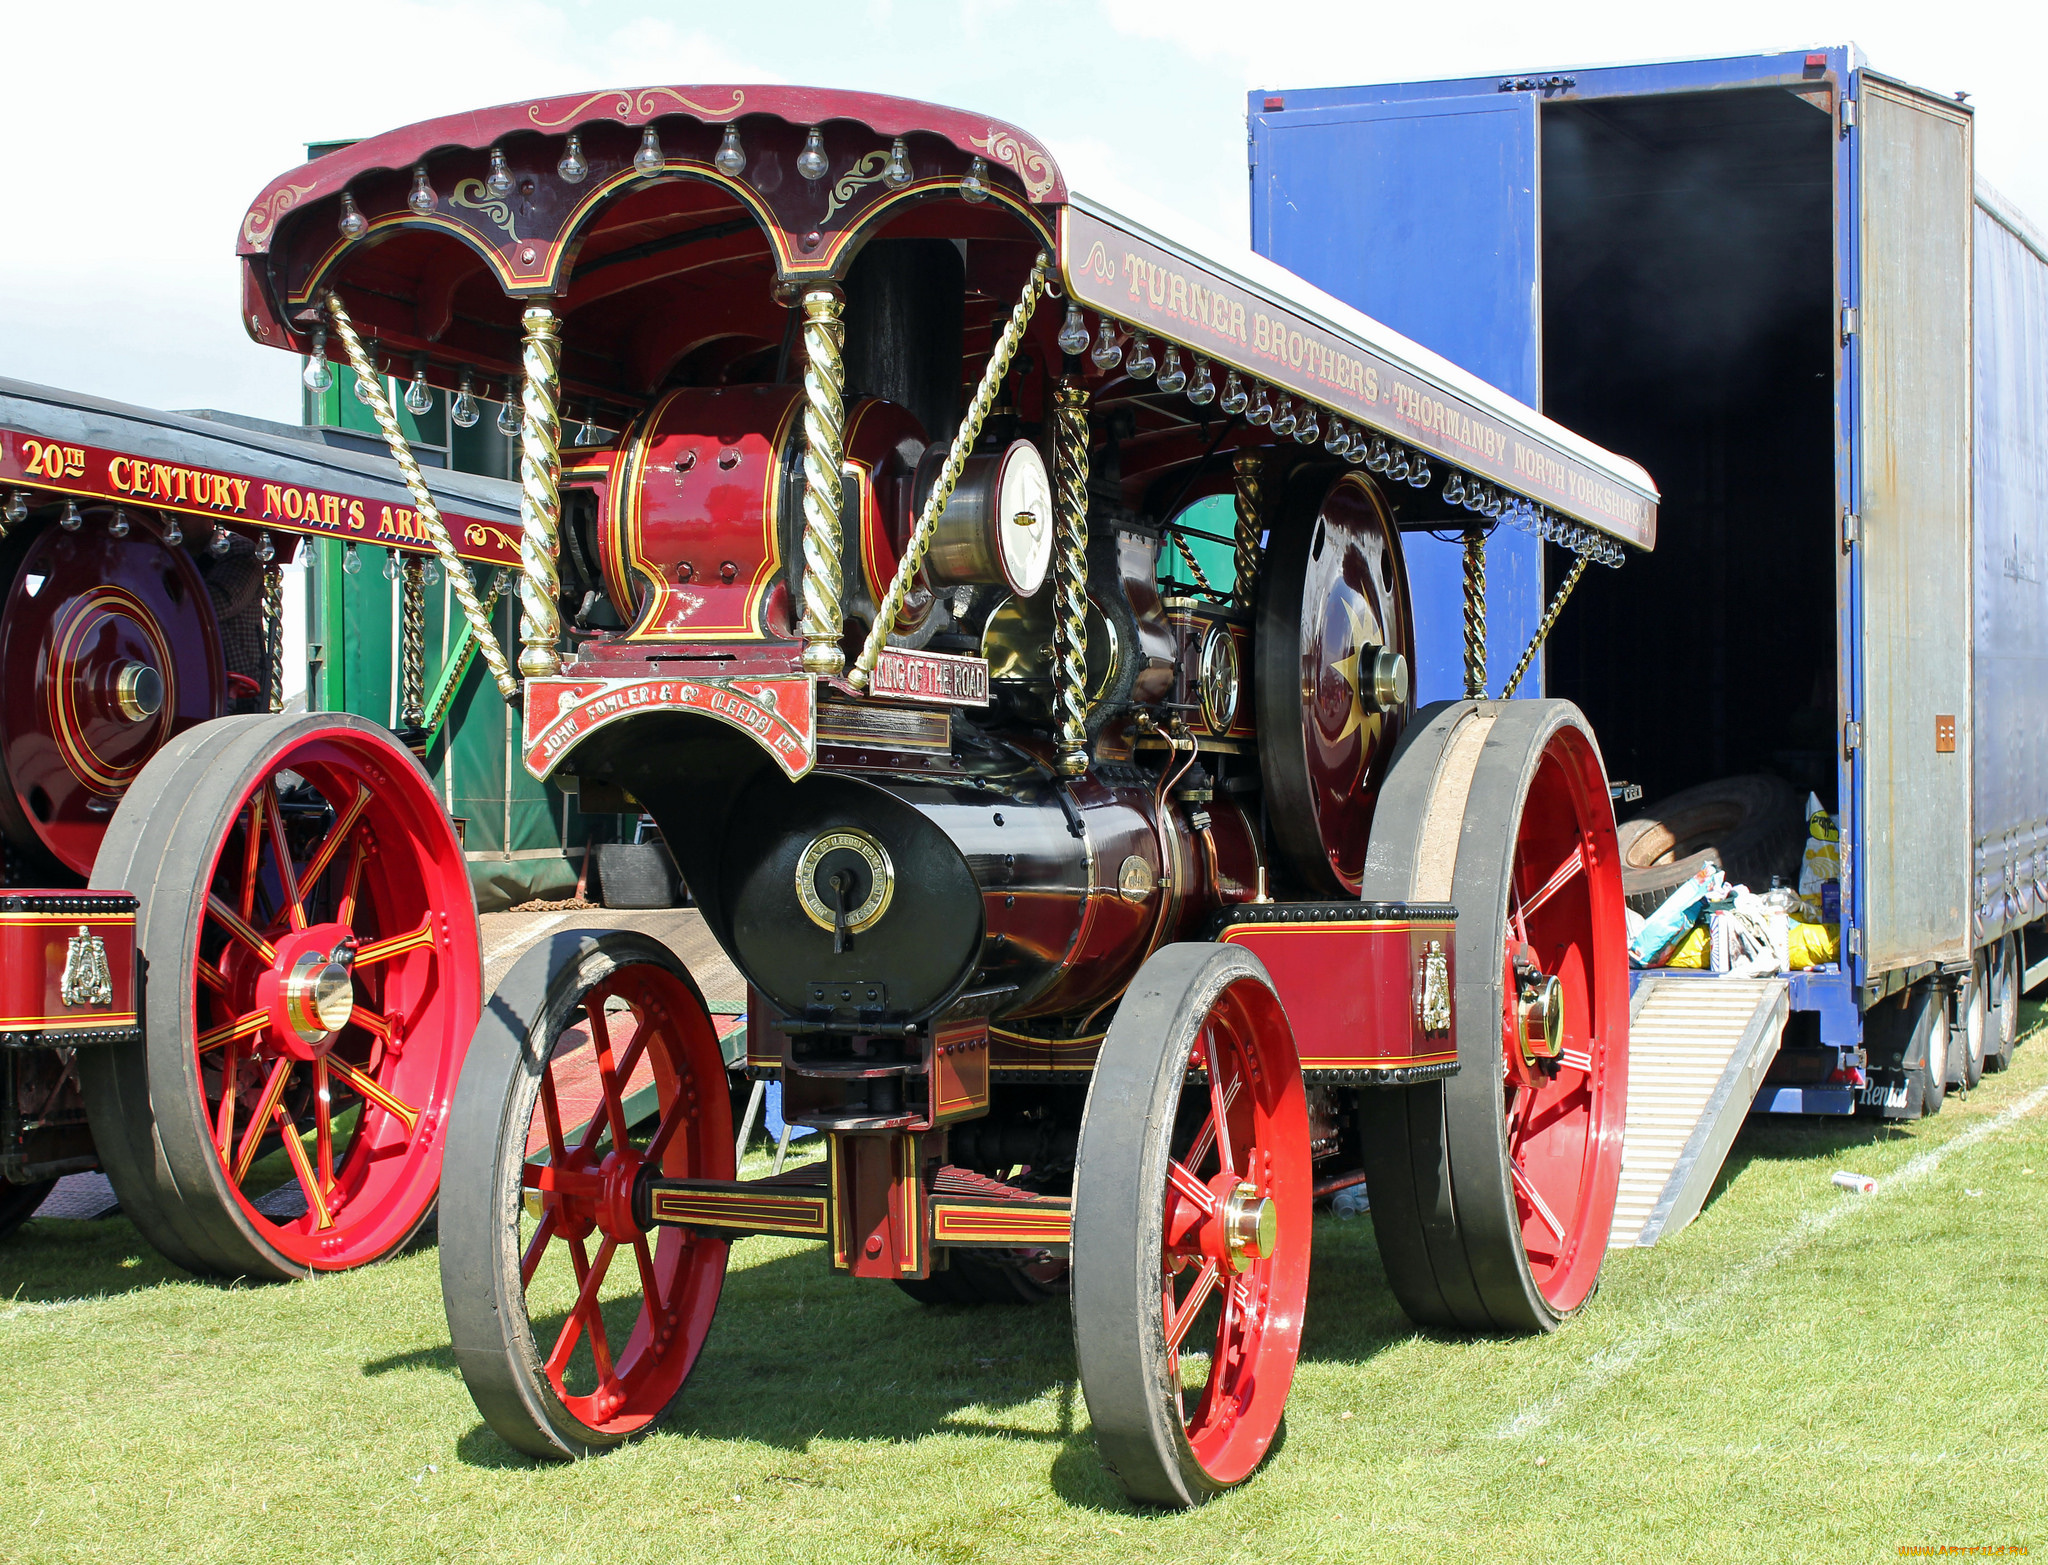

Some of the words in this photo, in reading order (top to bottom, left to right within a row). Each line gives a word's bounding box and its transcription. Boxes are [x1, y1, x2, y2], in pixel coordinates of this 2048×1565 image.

[1122, 252, 1247, 346] TURNER
[1252, 312, 1379, 406] BROTHERS
[1393, 380, 1506, 464] THORMANBY
[1513, 441, 1566, 495] NORTH
[1568, 468, 1640, 530] YORKSHIRE
[108, 456, 251, 512] CENTURY
[262, 484, 366, 533] NOAH'S
[875, 655, 905, 690] KING
[907, 660, 924, 692] OF
[926, 662, 952, 695] THE
[954, 665, 985, 698] ROAD
[542, 718, 580, 759] JOHN
[659, 684, 673, 701] &
[1858, 1076, 1910, 1109] Rental
